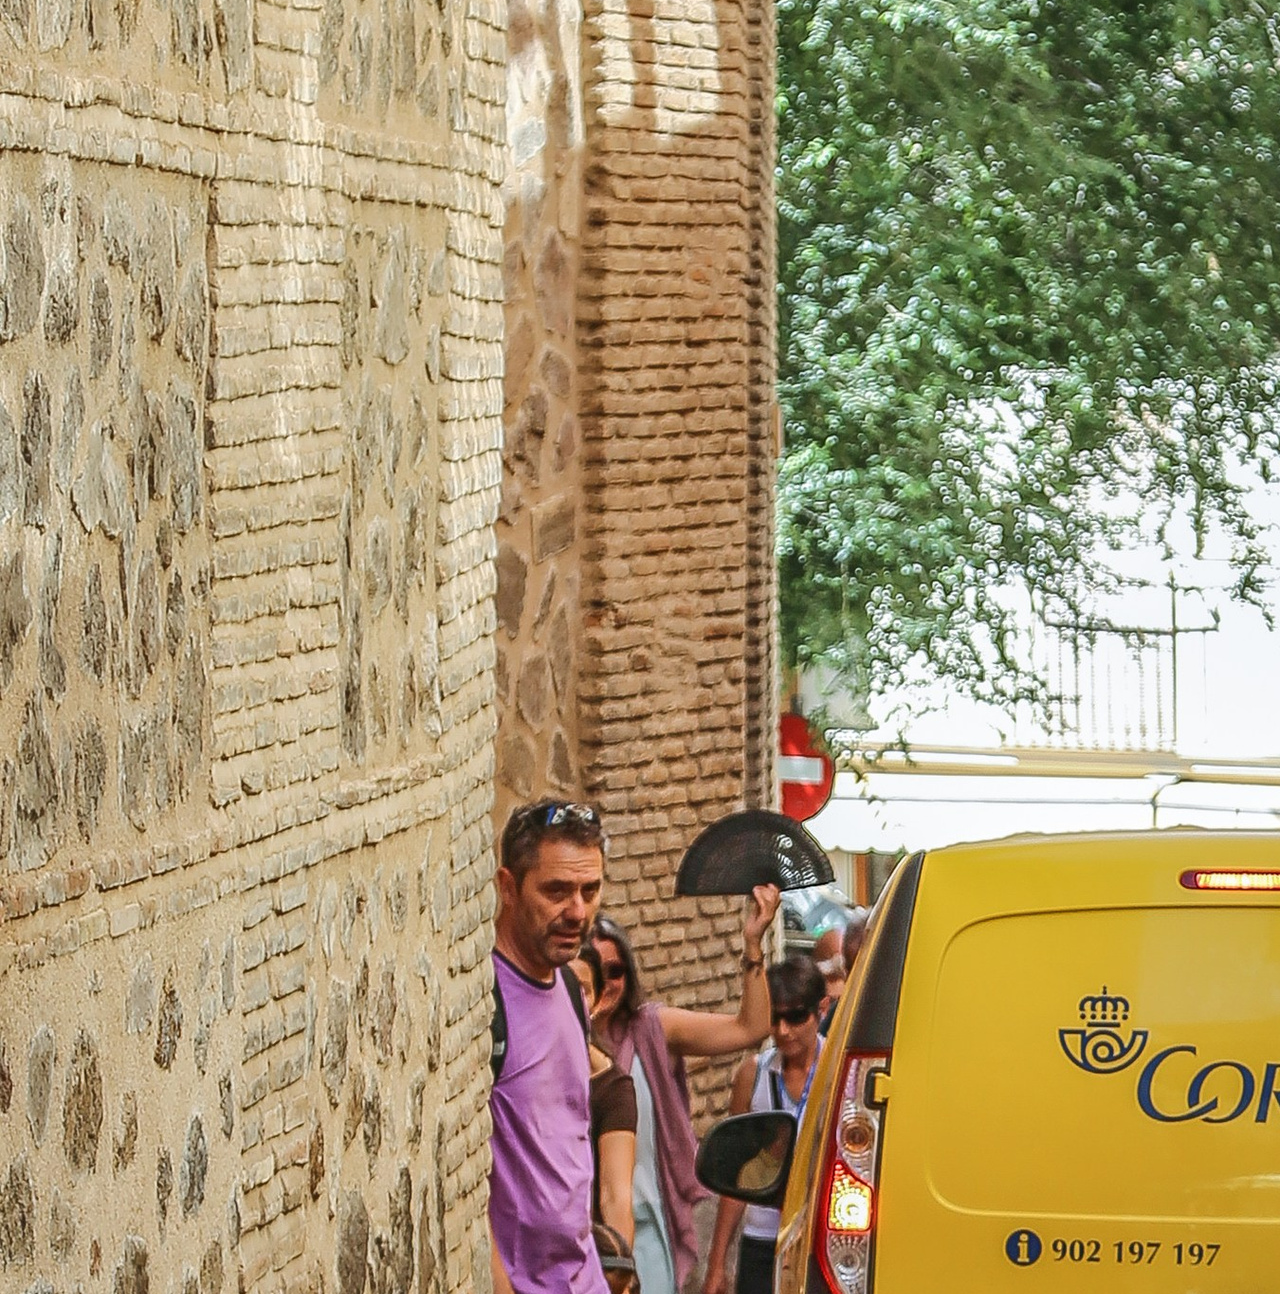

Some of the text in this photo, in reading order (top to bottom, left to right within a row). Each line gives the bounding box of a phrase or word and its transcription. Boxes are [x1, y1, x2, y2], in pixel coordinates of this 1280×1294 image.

[1052, 1239, 1101, 1262] 902
[1113, 1241, 1161, 1264] 197
[1173, 1243, 1221, 1266] 197
